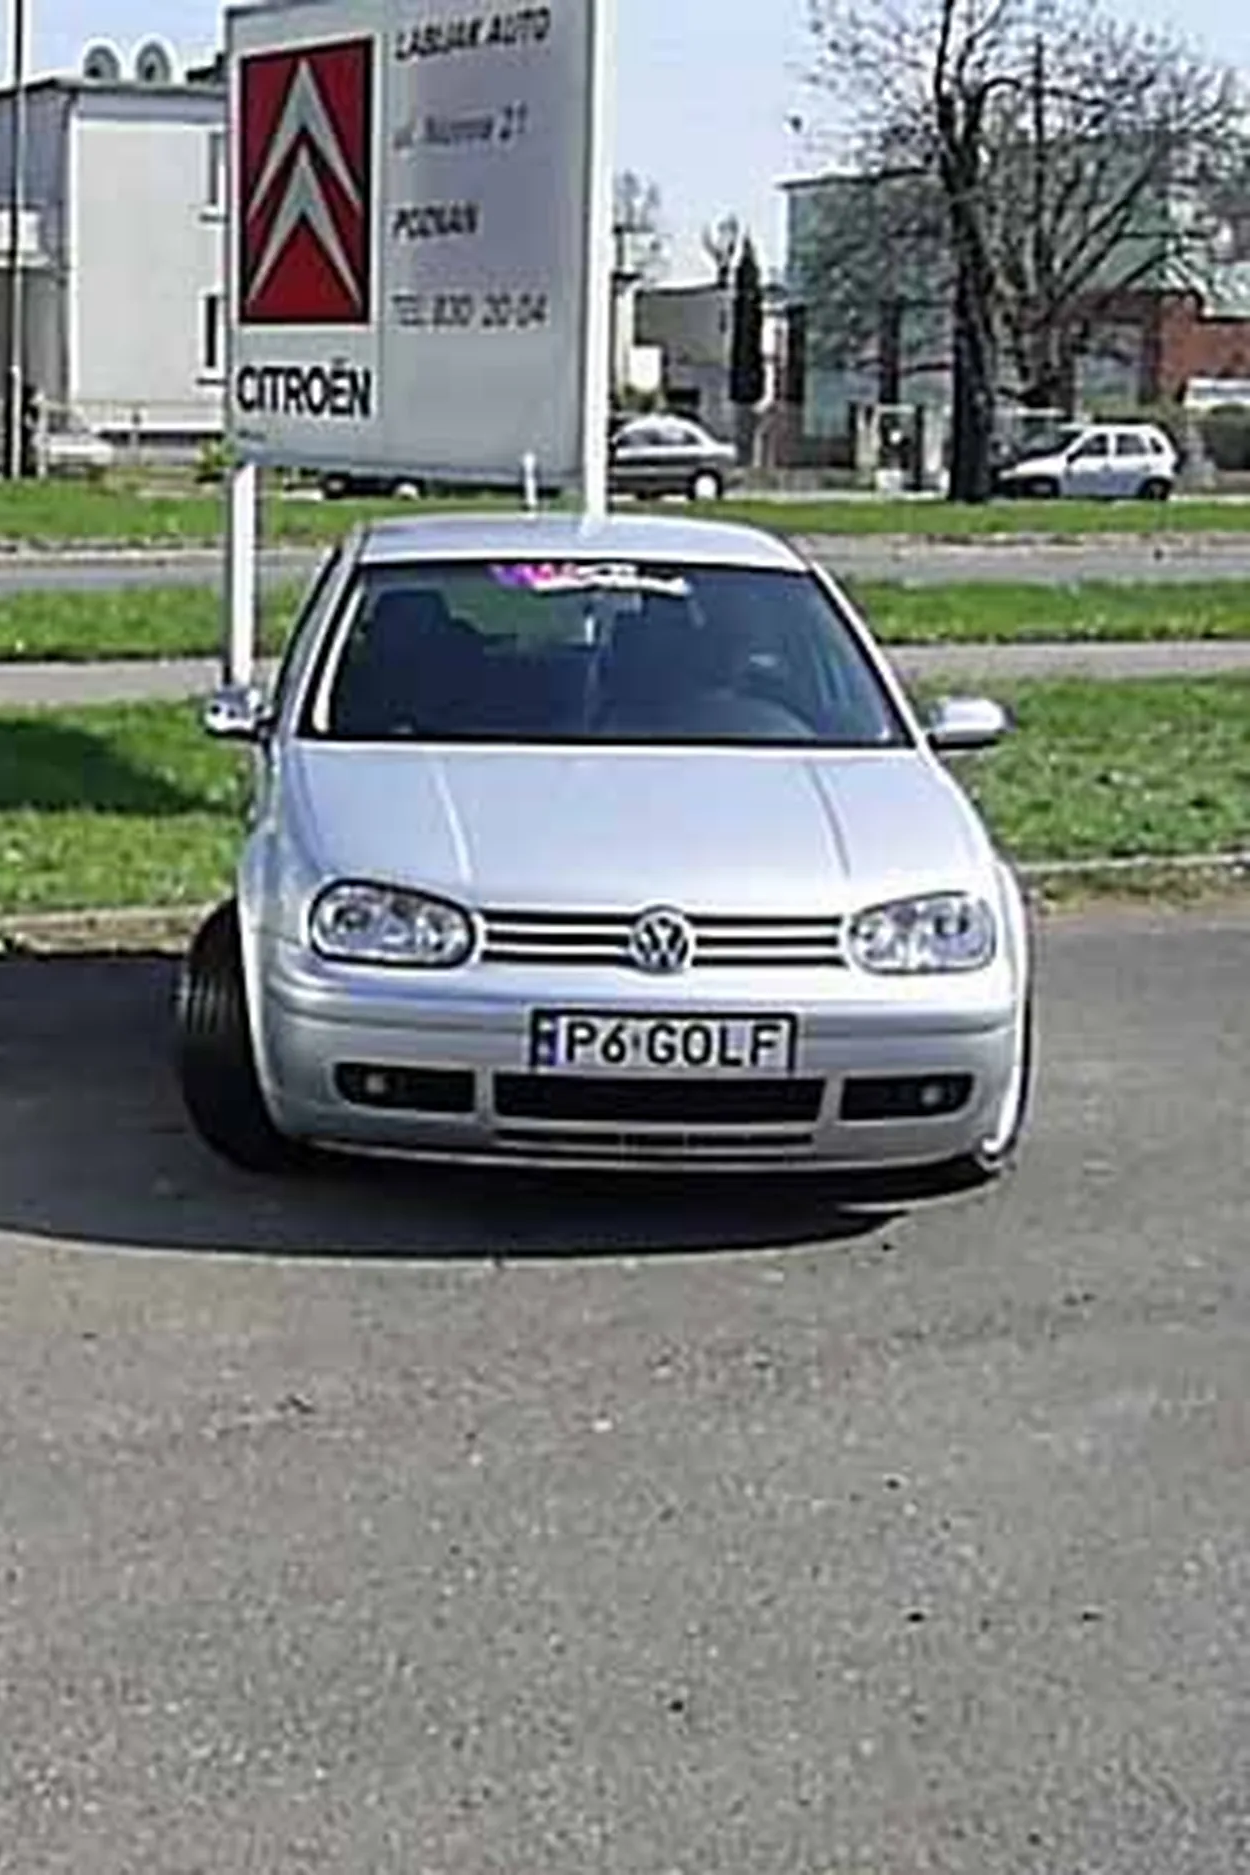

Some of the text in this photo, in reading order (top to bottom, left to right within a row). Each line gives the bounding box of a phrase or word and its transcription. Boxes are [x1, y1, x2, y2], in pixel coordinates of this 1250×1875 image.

[237, 357, 371, 419] CITROËN
[565, 1020, 627, 1064] P6
[647, 1022, 782, 1068] GOLF
